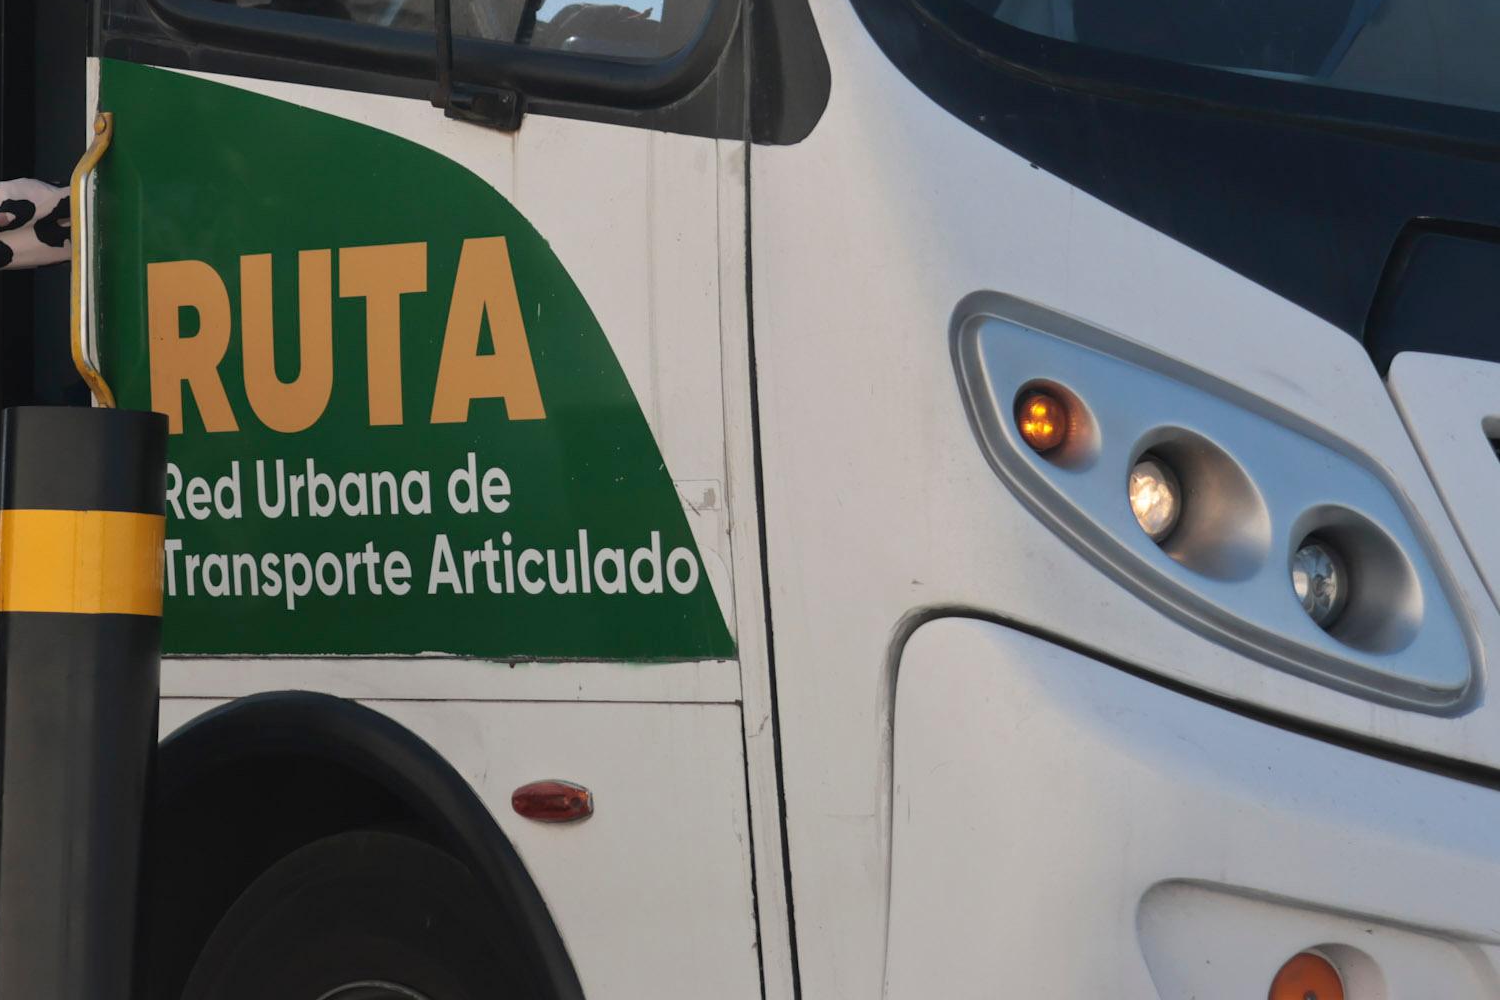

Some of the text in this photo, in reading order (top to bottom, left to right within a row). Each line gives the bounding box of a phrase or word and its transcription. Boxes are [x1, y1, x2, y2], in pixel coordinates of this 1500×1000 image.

[147, 236, 546, 435] RUTA
[166, 452, 512, 521] Red Urbana de
[164, 529, 699, 610] Transporte Articulado
